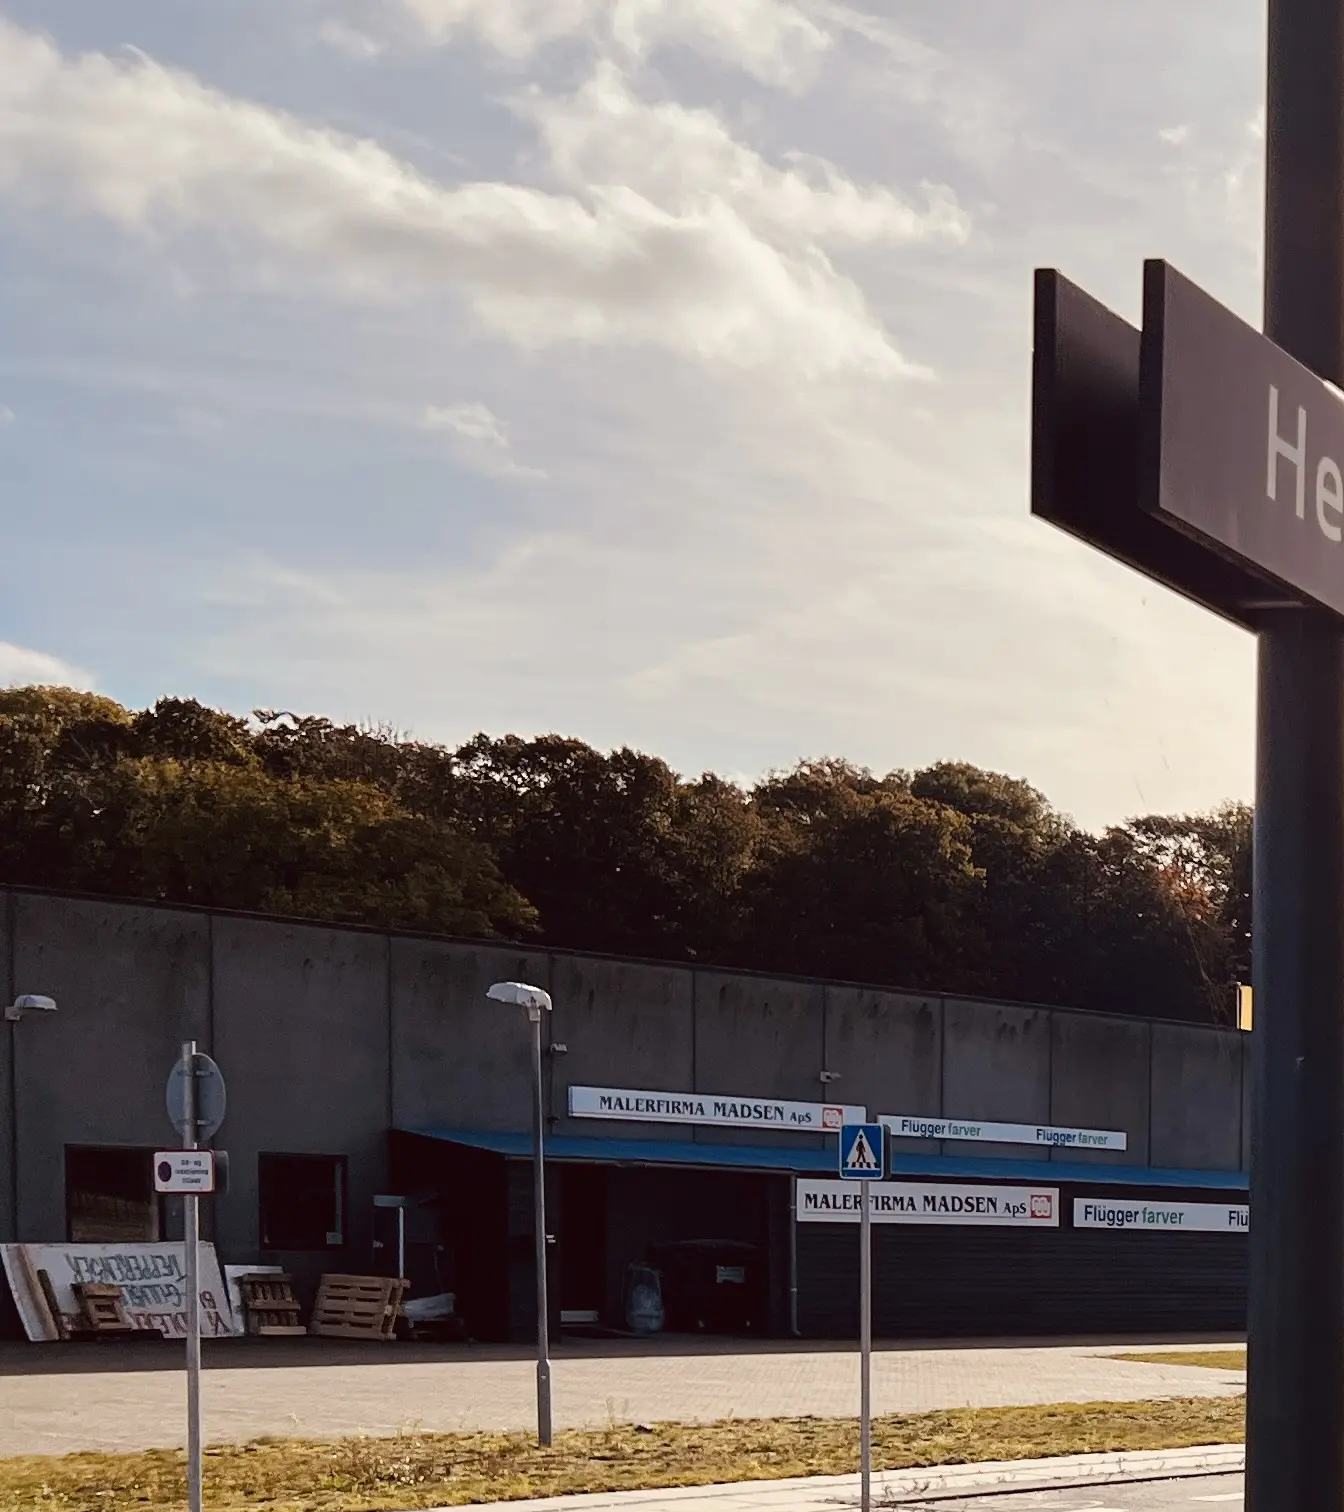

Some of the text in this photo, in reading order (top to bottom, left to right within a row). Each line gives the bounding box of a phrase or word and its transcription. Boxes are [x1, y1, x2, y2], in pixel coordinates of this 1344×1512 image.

[599, 1095, 812, 1125] MALERFIRMA MADSEN ApS
[901, 1119, 981, 1138] Flügger farver
[1078, 1131, 1108, 1145] farver
[922, 1195, 999, 1214] MADSEN
[1003, 1202, 1027, 1217] ApS
[1084, 1204, 1185, 1227] Flügger farver
